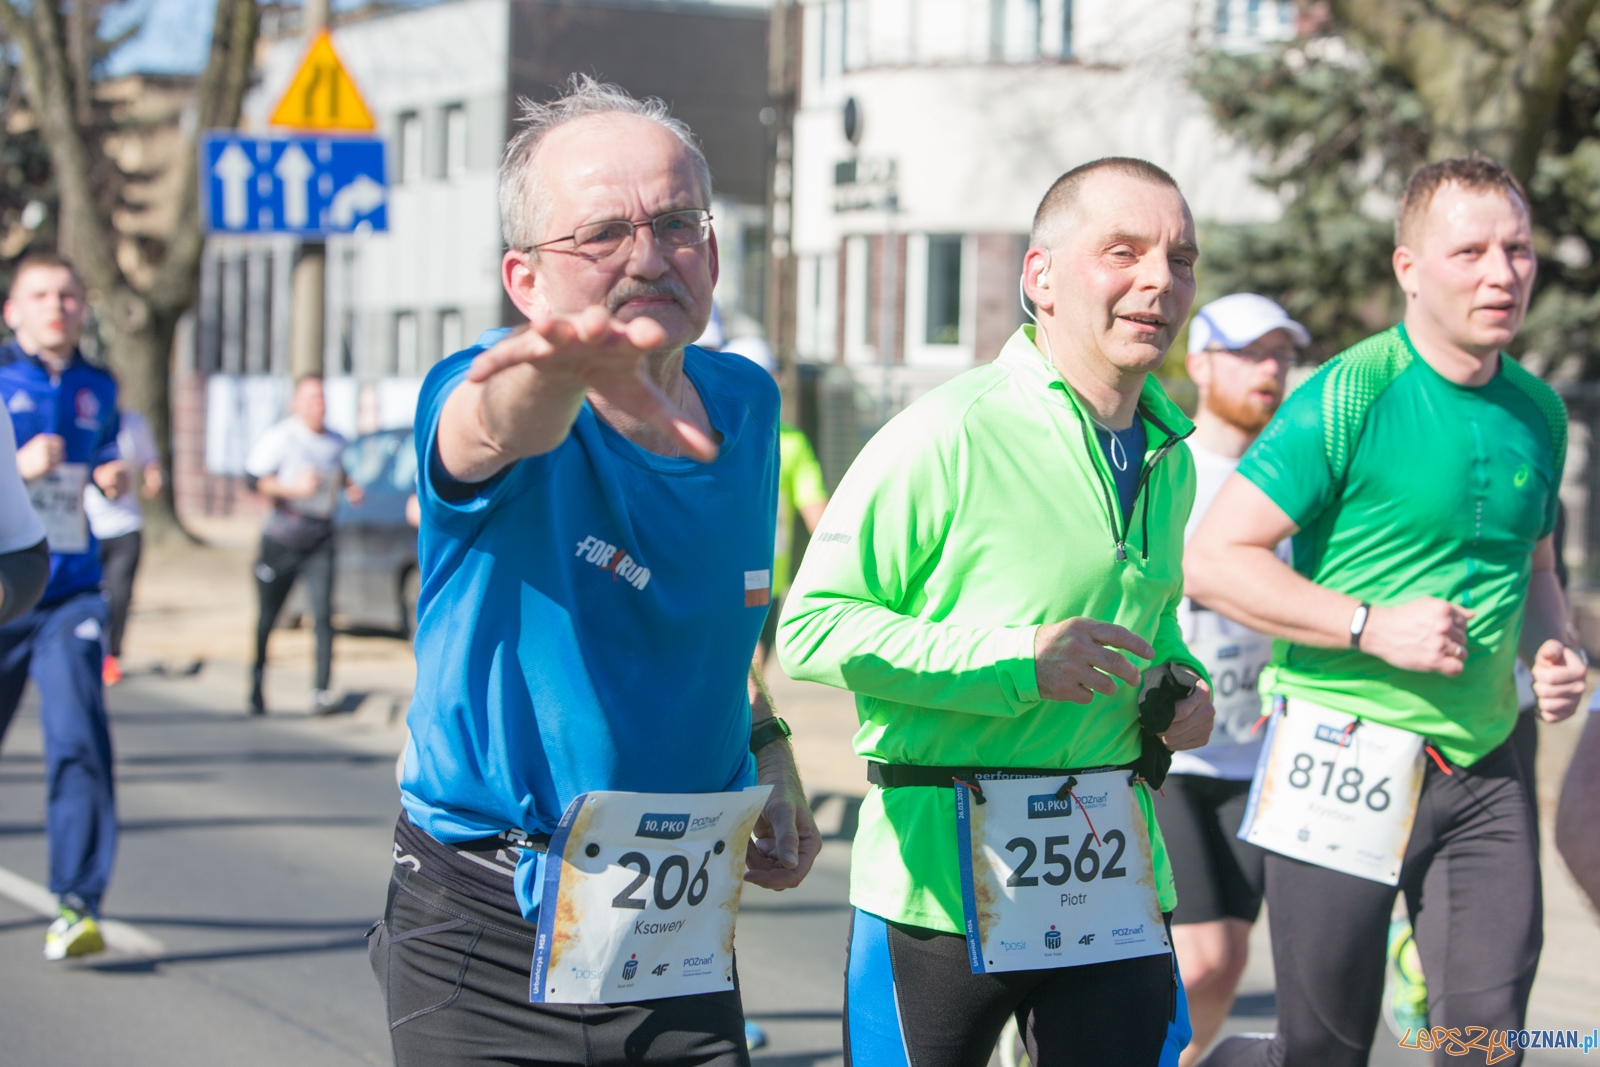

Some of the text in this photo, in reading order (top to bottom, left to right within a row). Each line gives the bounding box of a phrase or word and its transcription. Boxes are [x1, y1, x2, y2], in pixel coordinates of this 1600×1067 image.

[575, 535, 651, 591] FOR RUN
[1289, 753, 1391, 812] 8186
[1033, 800, 1068, 811] 10. PKO
[644, 820, 685, 833] 10. PKO
[1005, 829, 1126, 888] 2562
[612, 850, 711, 910] 206
[1060, 893, 1087, 907] Piotr
[634, 919, 686, 936] Ksawery
[970, 939, 979, 967] Urbaniak
